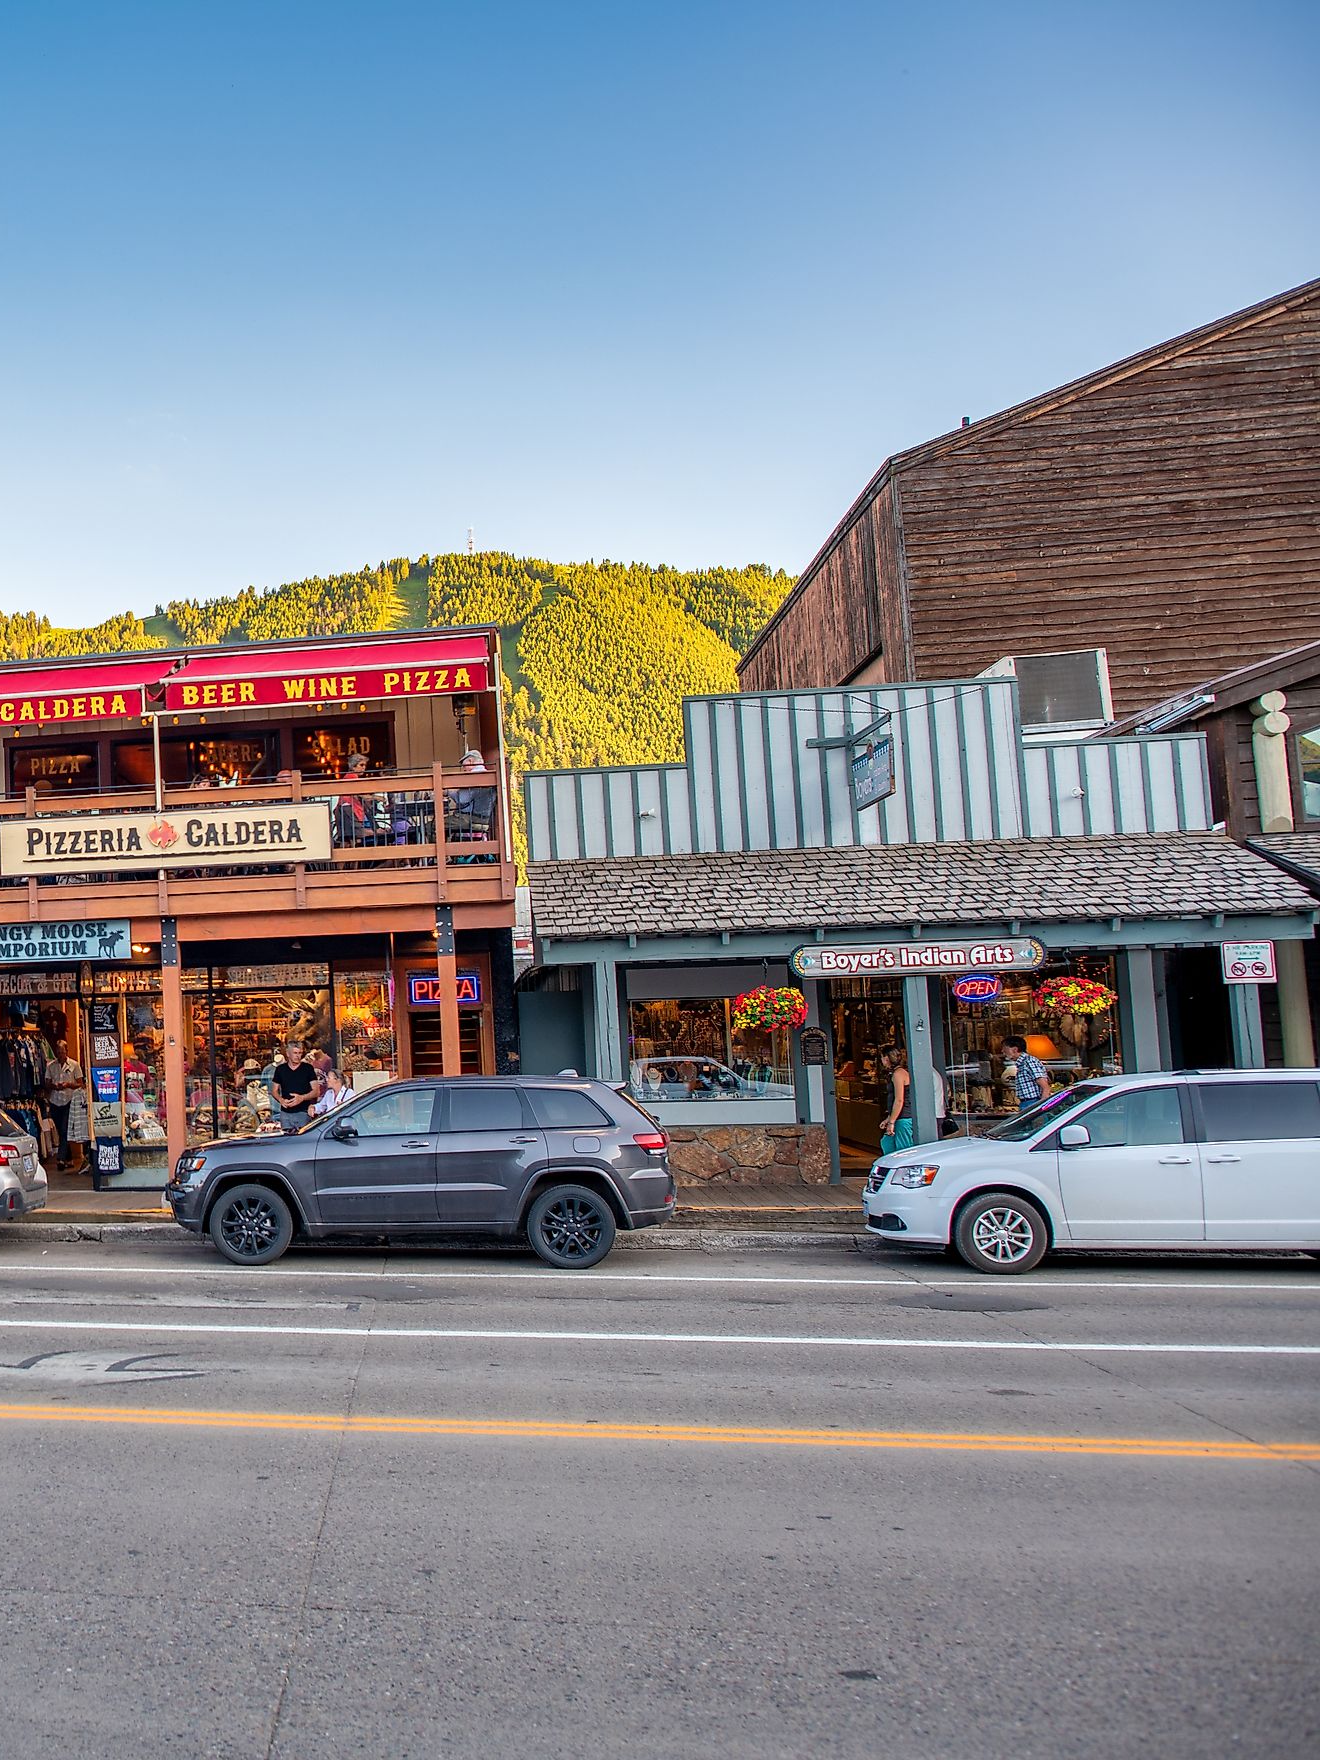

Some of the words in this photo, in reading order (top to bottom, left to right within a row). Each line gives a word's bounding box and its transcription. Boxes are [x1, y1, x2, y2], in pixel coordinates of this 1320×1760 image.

[182, 681, 257, 706] BEER
[282, 676, 358, 700] WINE
[383, 667, 472, 694] PIZZA
[0, 694, 127, 722] CALDERA
[30, 757, 81, 776] PIZZA
[26, 827, 143, 856] PIZZERIA
[185, 818, 303, 847] CALDERA
[41, 922, 108, 940] MOOSE
[821, 949, 896, 972] Boyer's
[901, 947, 964, 967] Indian
[970, 944, 1015, 966] Arts
[955, 980, 1000, 996] OPEN
[98, 1087, 118, 1095] FRIES
